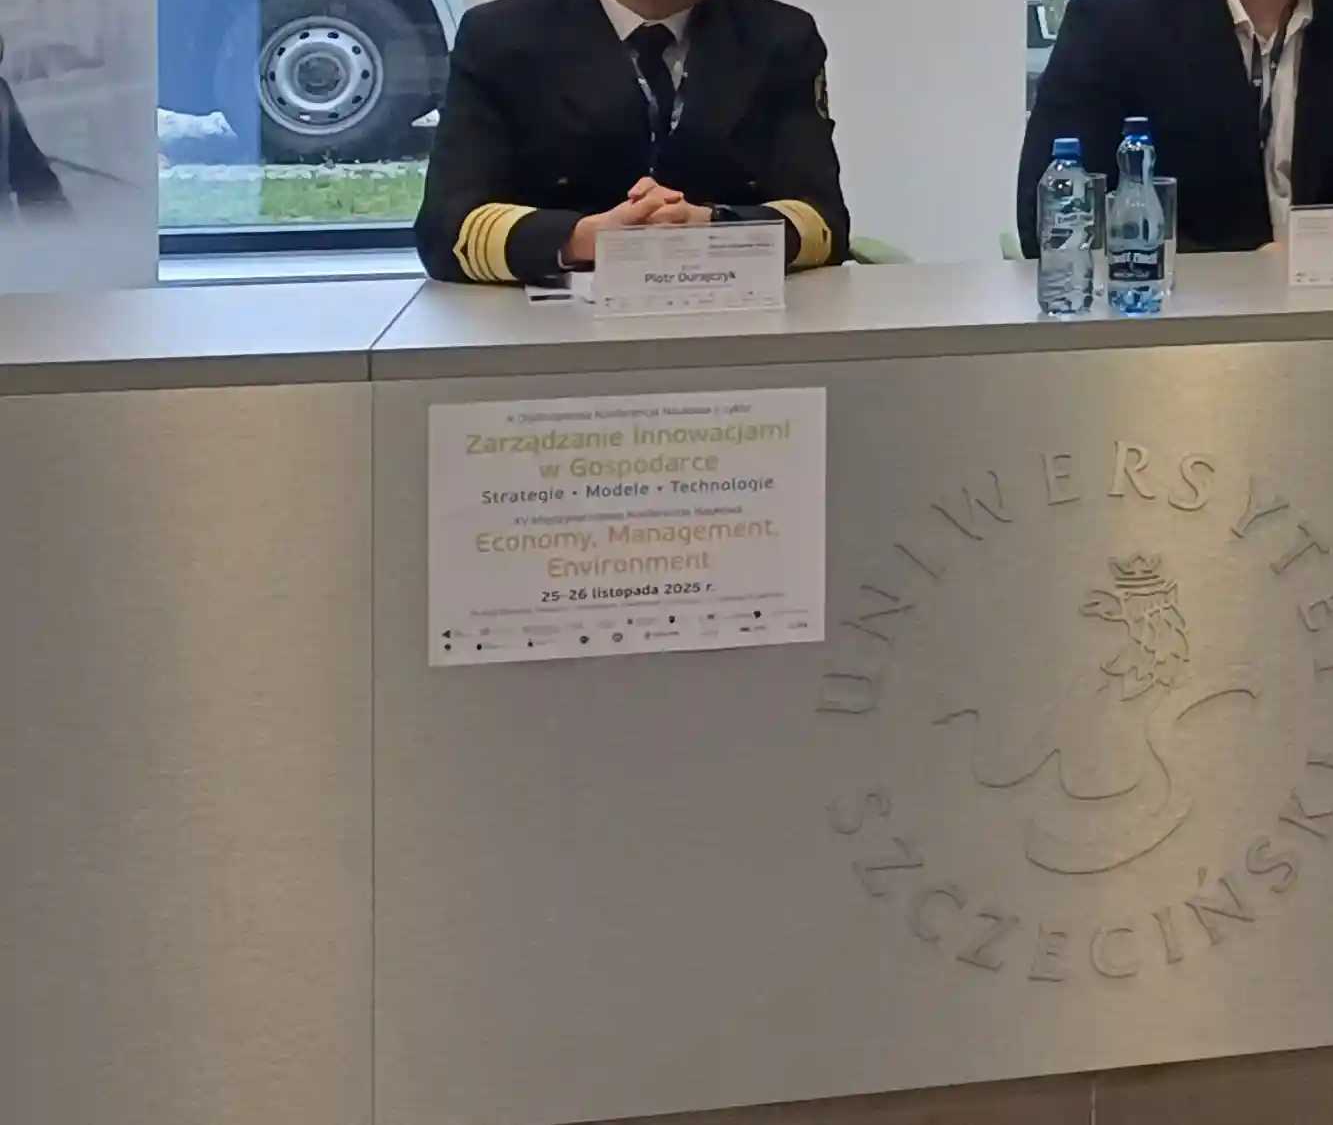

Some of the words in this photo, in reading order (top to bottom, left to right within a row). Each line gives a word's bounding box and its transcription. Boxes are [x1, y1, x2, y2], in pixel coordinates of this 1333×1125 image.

[465, 428, 623, 456] Zarządzanie
[633, 420, 791, 445] Innowacjami
[539, 463, 560, 479] w
[570, 453, 719, 482] Gospodarce
[482, 487, 564, 506] Strategie
[586, 483, 649, 499] Modele
[671, 476, 774, 494] Technologie
[476, 531, 597, 554] Economy,
[608, 519, 780, 546] Management,
[547, 552, 709, 578] Environment
[541, 588, 587, 602] 25-26
[592, 584, 659, 601] listopada
[664, 582, 701, 595] 2025
